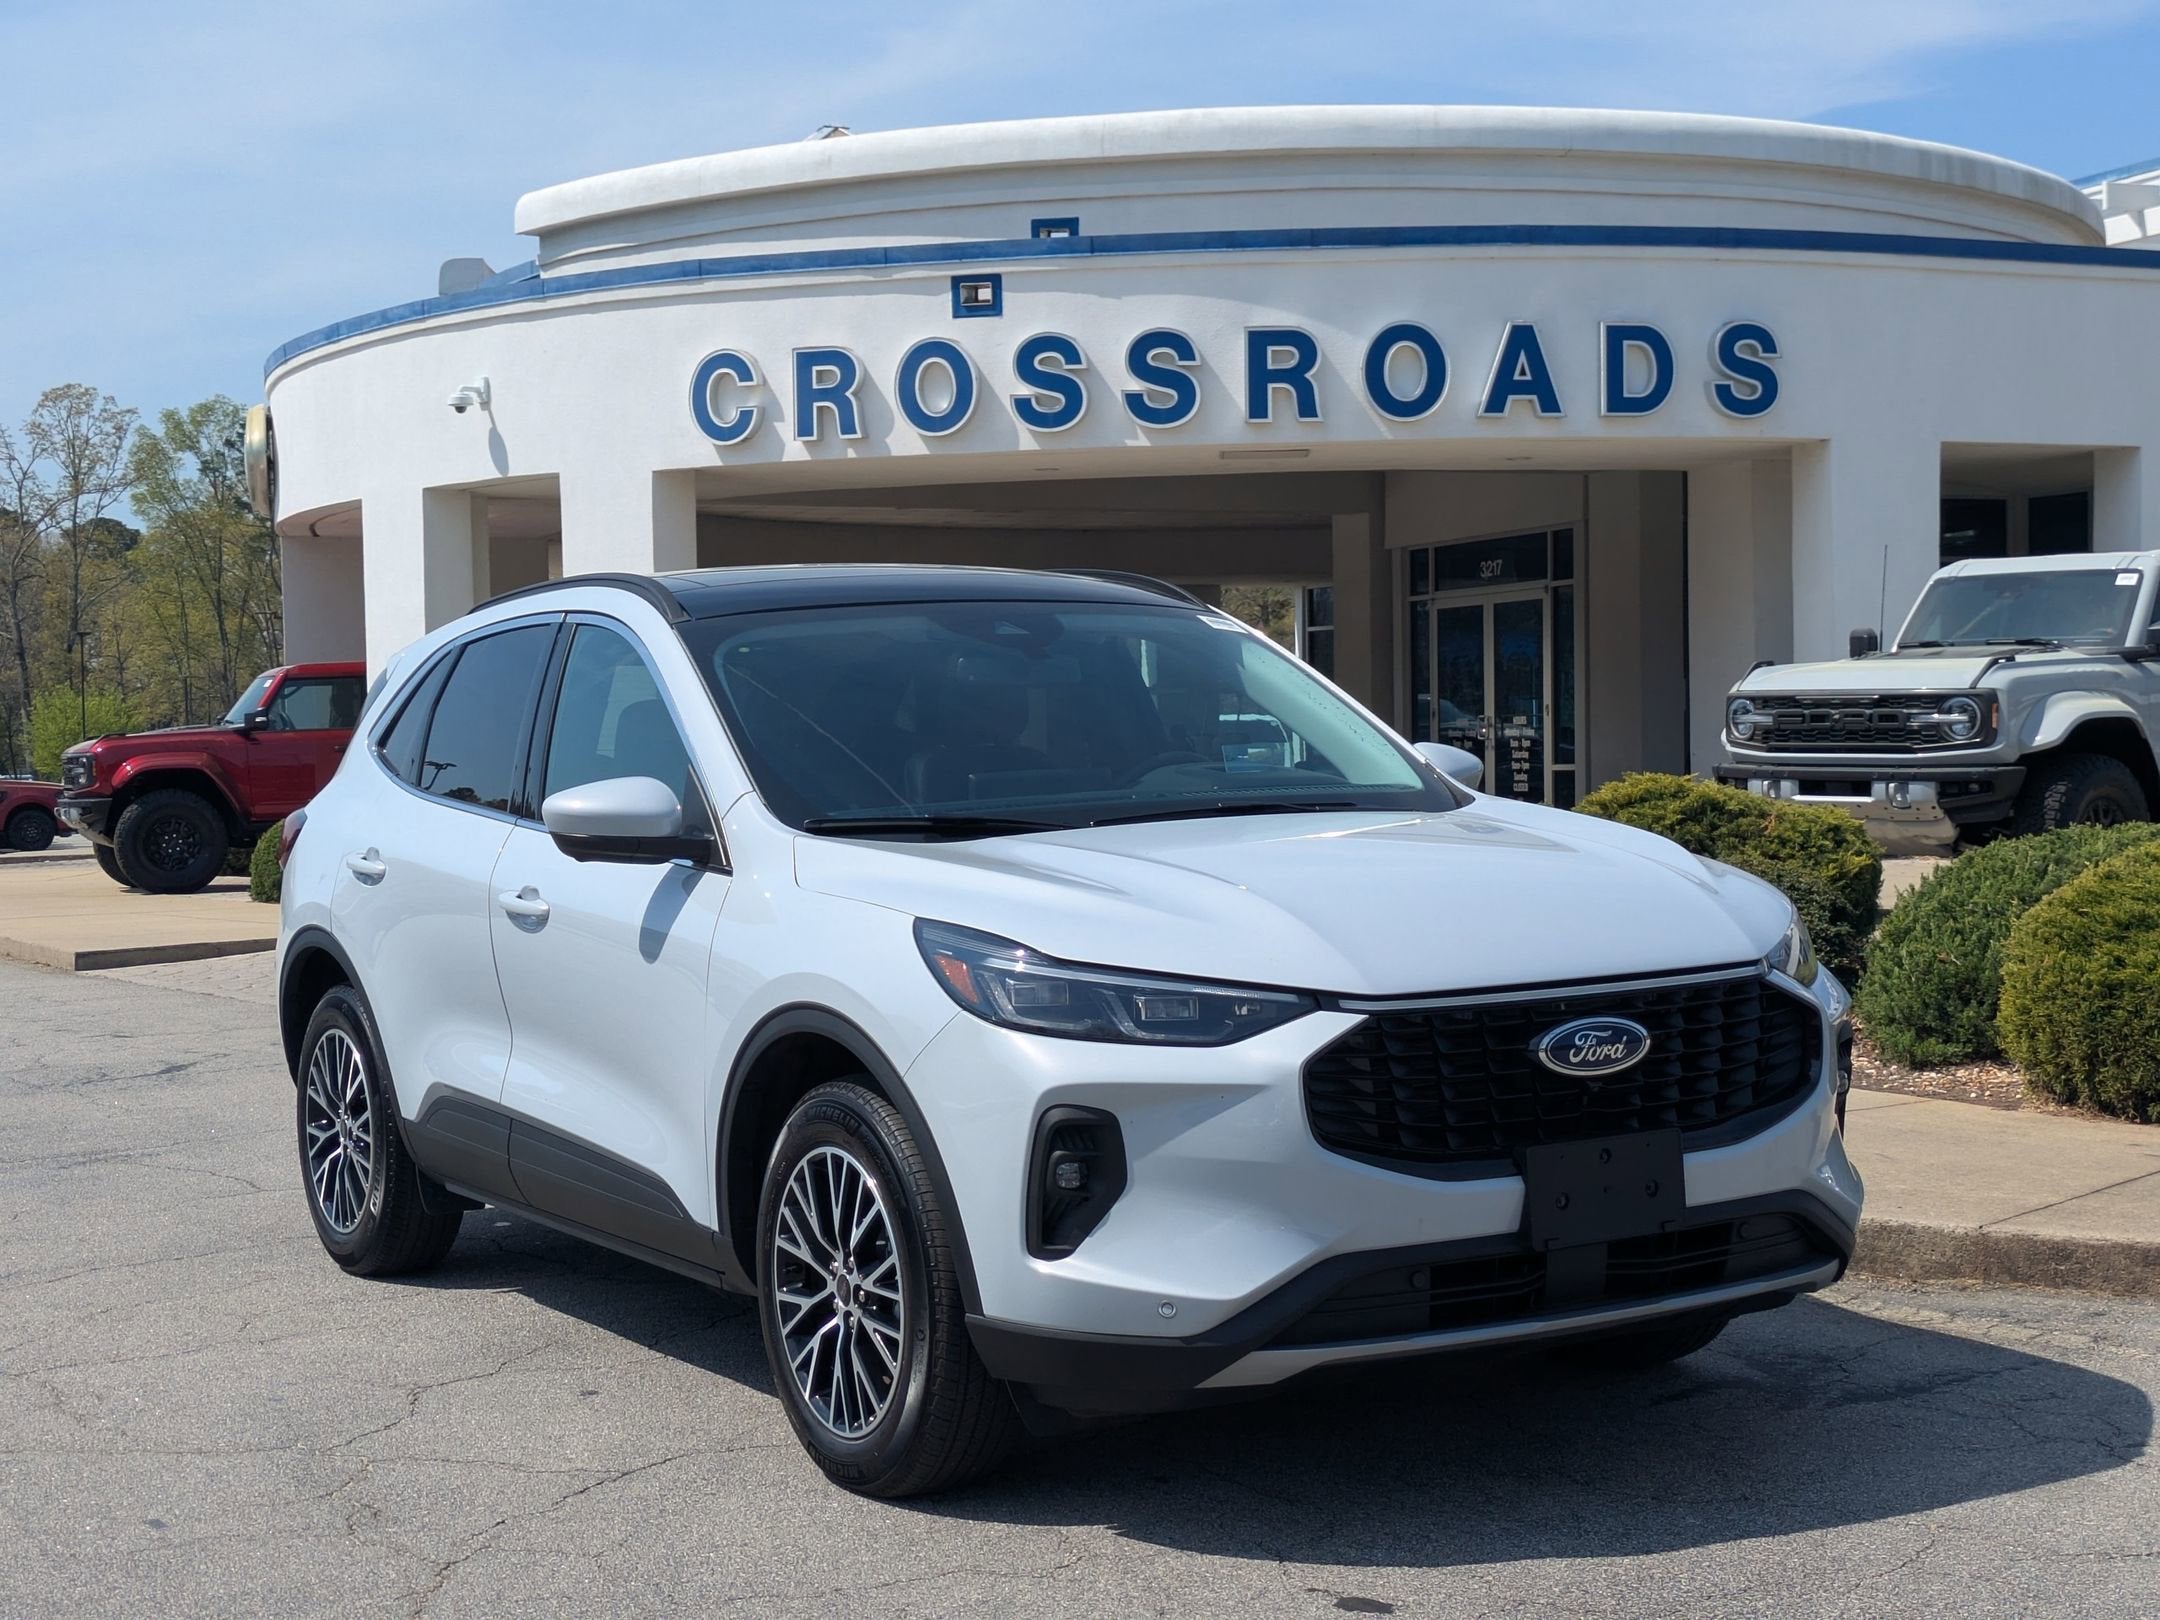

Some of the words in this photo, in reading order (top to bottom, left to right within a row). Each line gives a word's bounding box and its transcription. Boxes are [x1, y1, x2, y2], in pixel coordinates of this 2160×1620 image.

[689, 320, 1782, 446] CROSSROADS
[1480, 559, 1502, 577] 3217
[1773, 708, 1906, 730] FORD
[1569, 1030, 1627, 1063] Ford
[806, 1106, 860, 1134] MICHELIN
